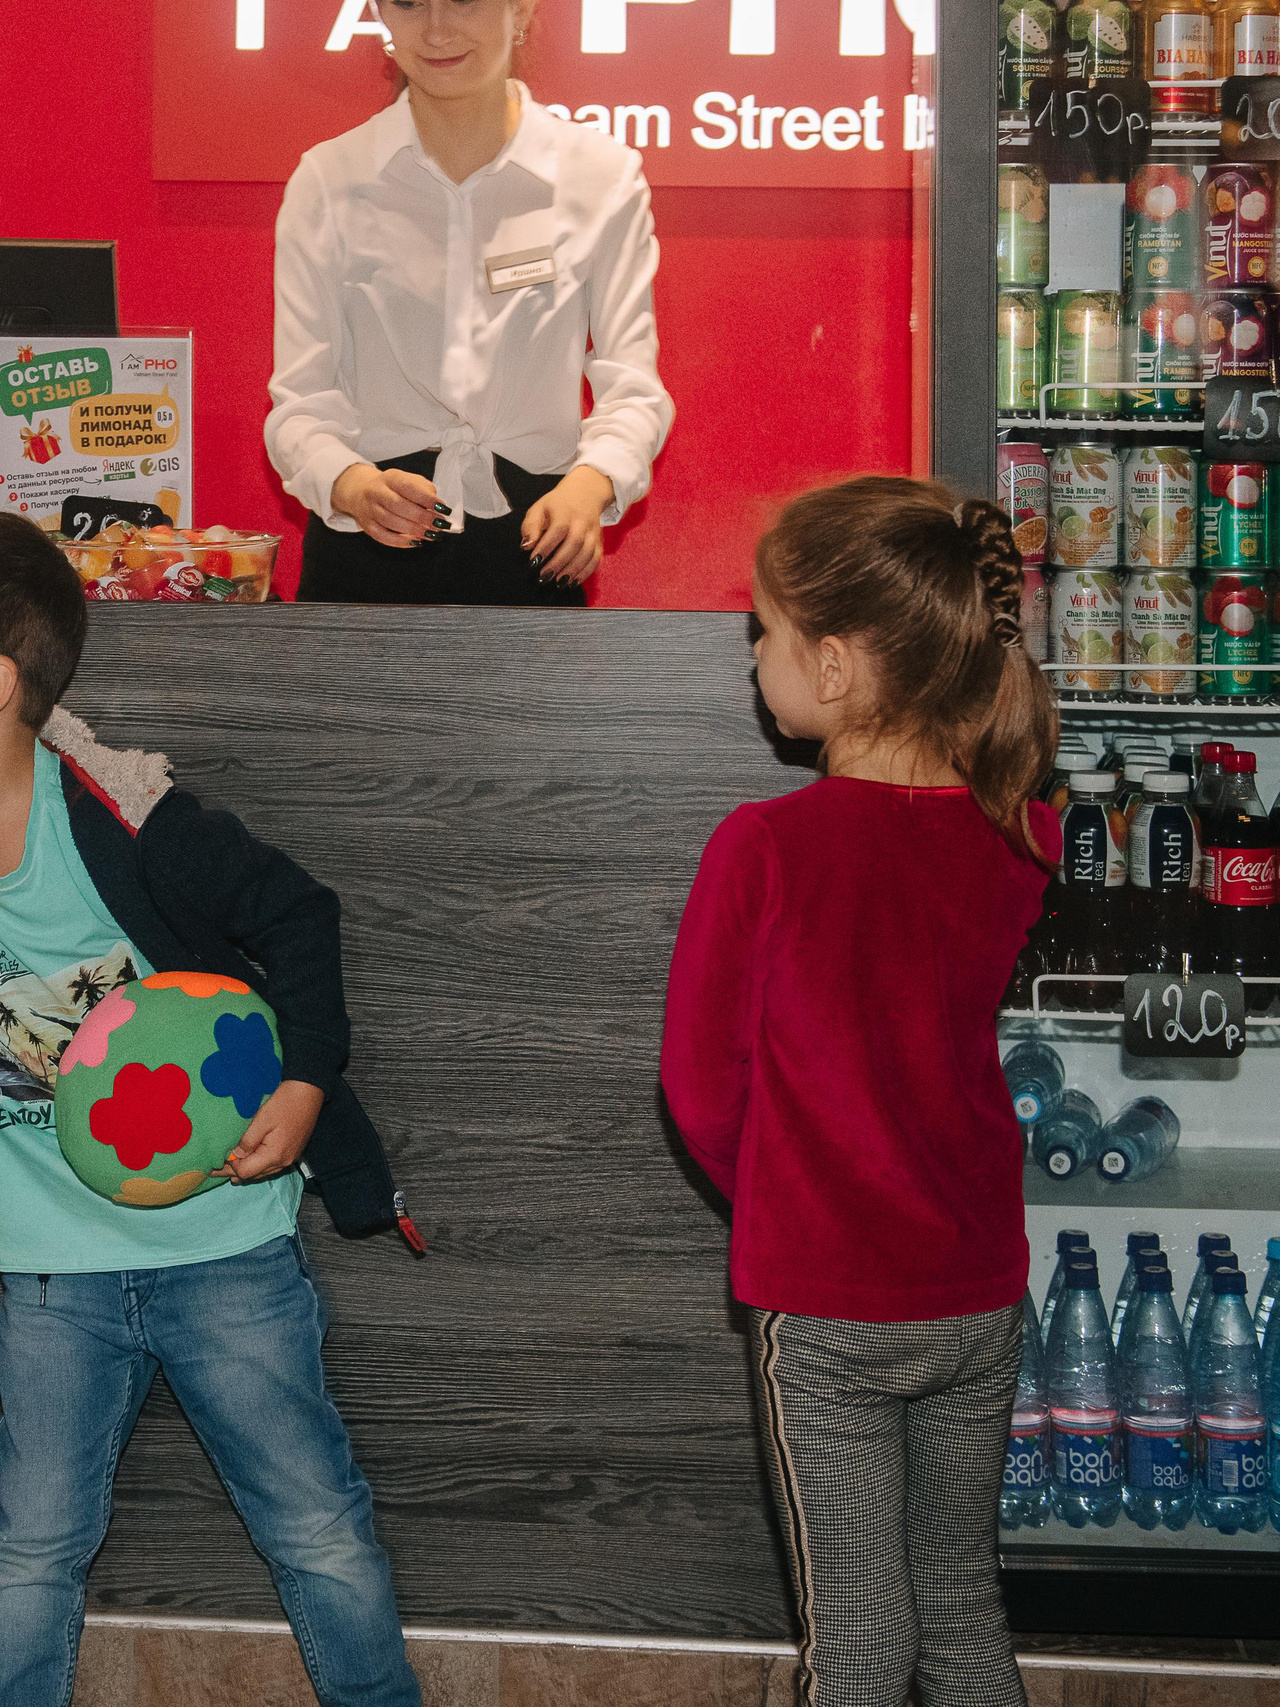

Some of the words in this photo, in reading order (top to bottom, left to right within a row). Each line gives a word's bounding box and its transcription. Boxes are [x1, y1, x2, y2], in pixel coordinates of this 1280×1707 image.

[691, 91, 884, 151] Street
[8, 356, 99, 386] ОСТАВЬ
[144, 359, 178, 370] PHO
[12, 378, 92, 407] ОТЗЫВ
[80, 407, 89, 417] И
[94, 404, 152, 416] ПОЛУЧИ
[1217, 389, 1280, 440] 15
[80, 419, 153, 433] ЛИМОНАД
[81, 437, 90, 447] В
[95, 434, 167, 448] ПОДАРОК!
[6, 473, 35, 481] Оставь
[36, 469, 59, 478] отзыв
[60, 468, 70, 476] на
[71, 464, 97, 474] любом
[102, 459, 135, 473] Яндекс
[18, 480, 47, 490] данных
[49, 476, 84, 488] ресурсов
[1133, 469, 1158, 484] Vinut
[20, 490, 49, 499] Покажи
[31, 501, 59, 510] Получи
[1069, 593, 1098, 609] Vinut
[1133, 596, 1160, 612] Vinut
[1074, 831, 1093, 881] Rich
[1162, 832, 1182, 882] Rich
[1094, 861, 1104, 881] tea
[1181, 862, 1191, 882] tea
[1069, 1447, 1112, 1468] bon
[1153, 1463, 1182, 1476] bon
